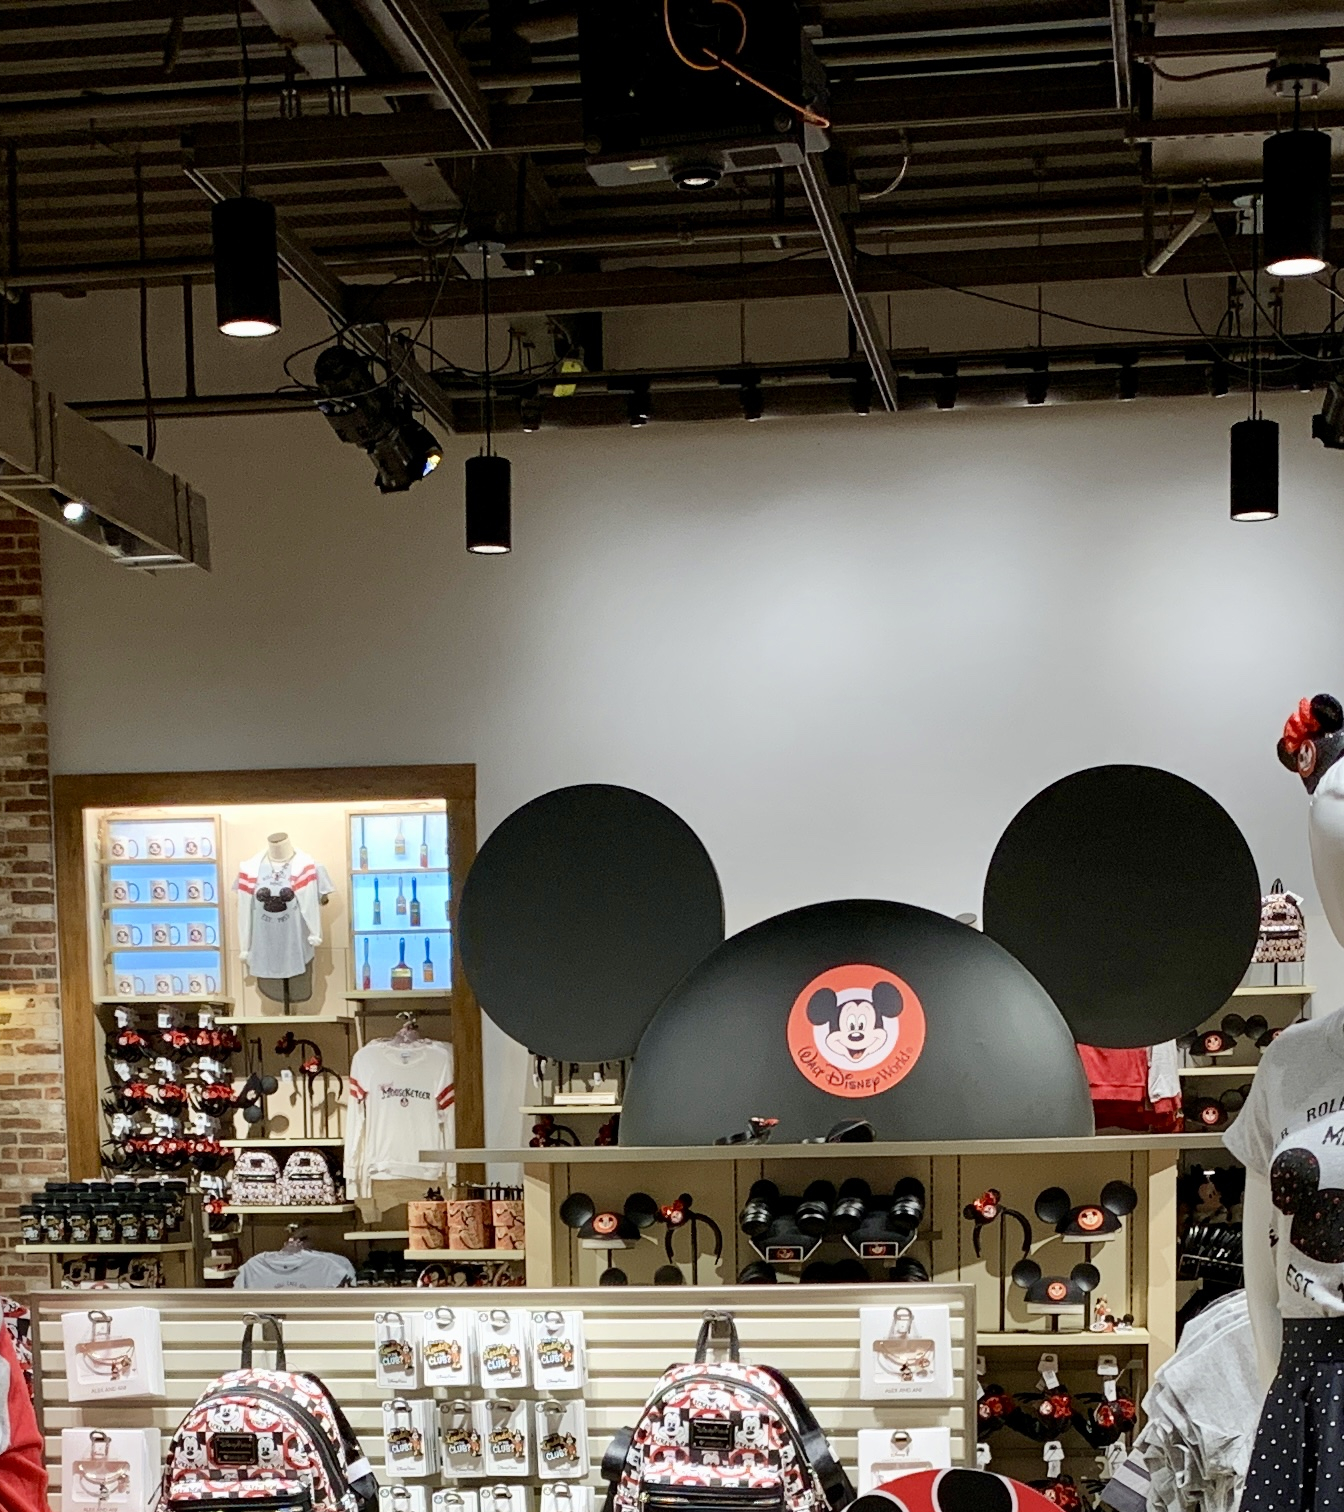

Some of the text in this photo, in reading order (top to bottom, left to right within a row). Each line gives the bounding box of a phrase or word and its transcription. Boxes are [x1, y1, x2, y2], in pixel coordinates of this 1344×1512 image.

[798, 1045, 911, 1093] Walt Disney World
[1285, 1263, 1316, 1301] EST.
[428, 1355, 452, 1367] CLUB?
[487, 1358, 511, 1371] CLUB?
[492, 1442, 515, 1454] CLUB?
